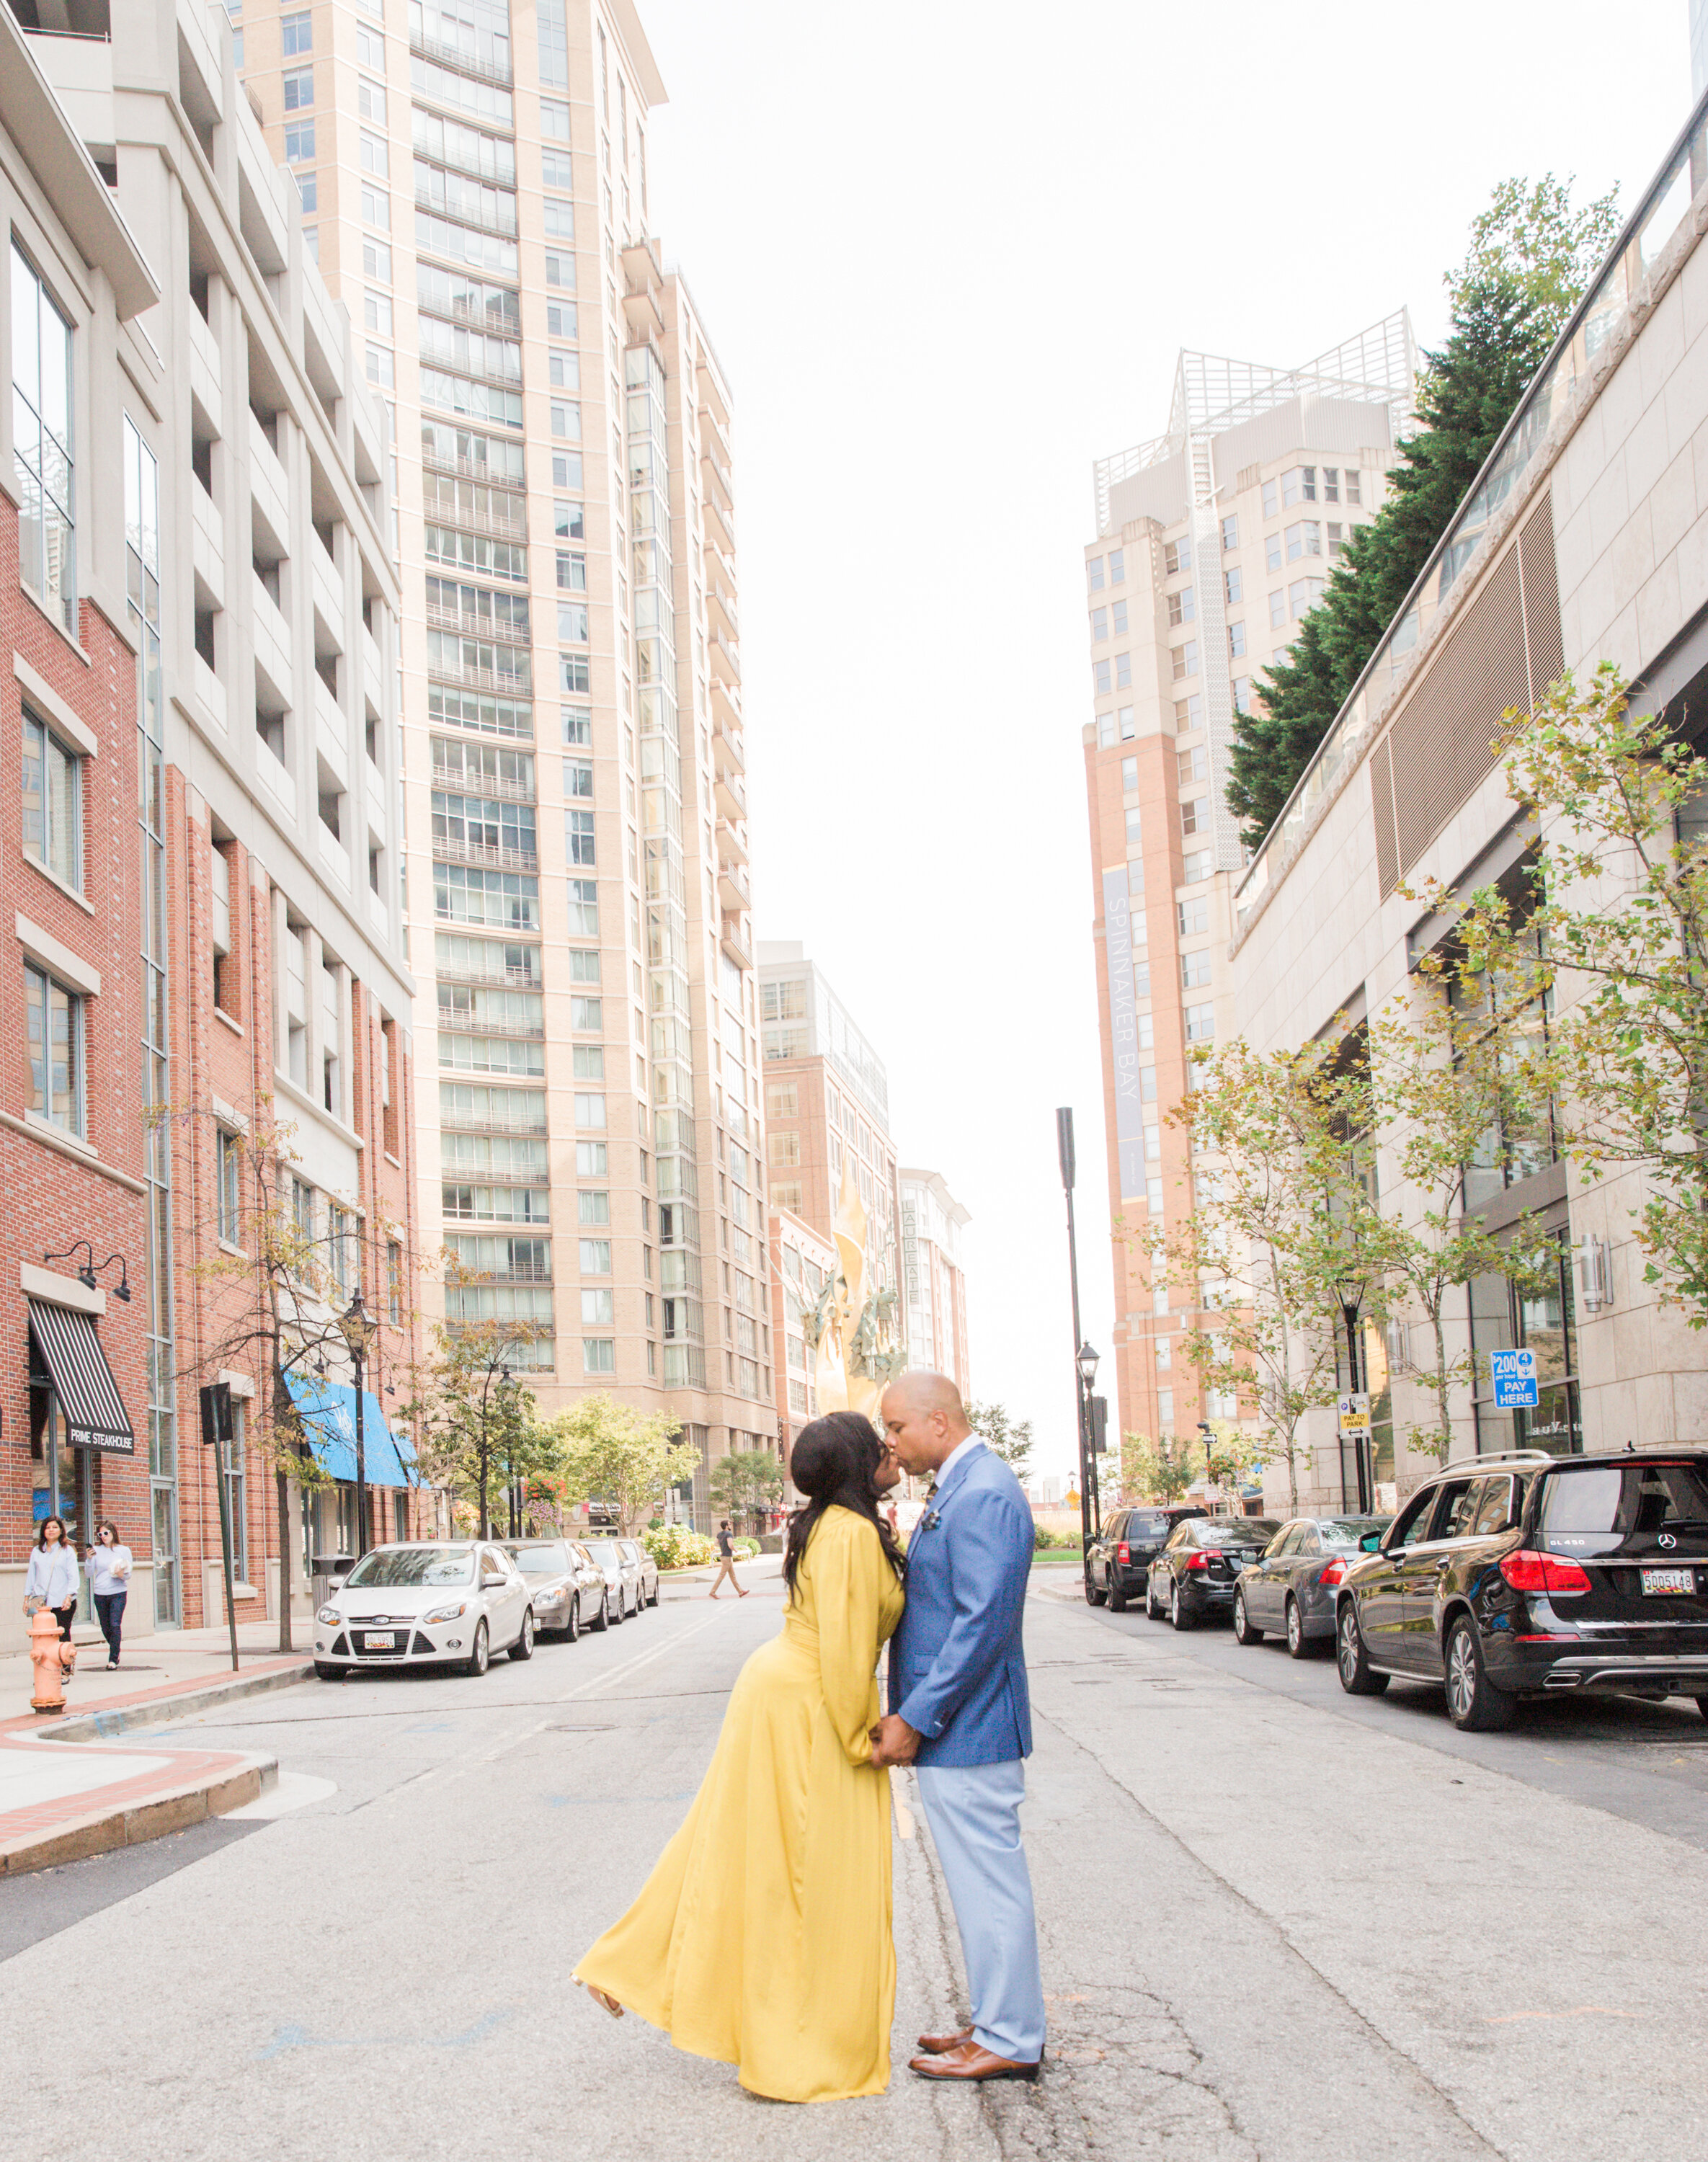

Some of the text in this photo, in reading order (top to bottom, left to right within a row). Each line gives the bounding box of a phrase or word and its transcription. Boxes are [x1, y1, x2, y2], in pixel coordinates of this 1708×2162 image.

[1108, 897, 1137, 1099] SPINNAKER BAY
[904, 1200, 918, 1303] LAUREATE
[1504, 1381, 1527, 1392] PAY
[1500, 1392, 1534, 1405] HERE
[71, 1428, 133, 1449] PRIME STEAKHOUSE
